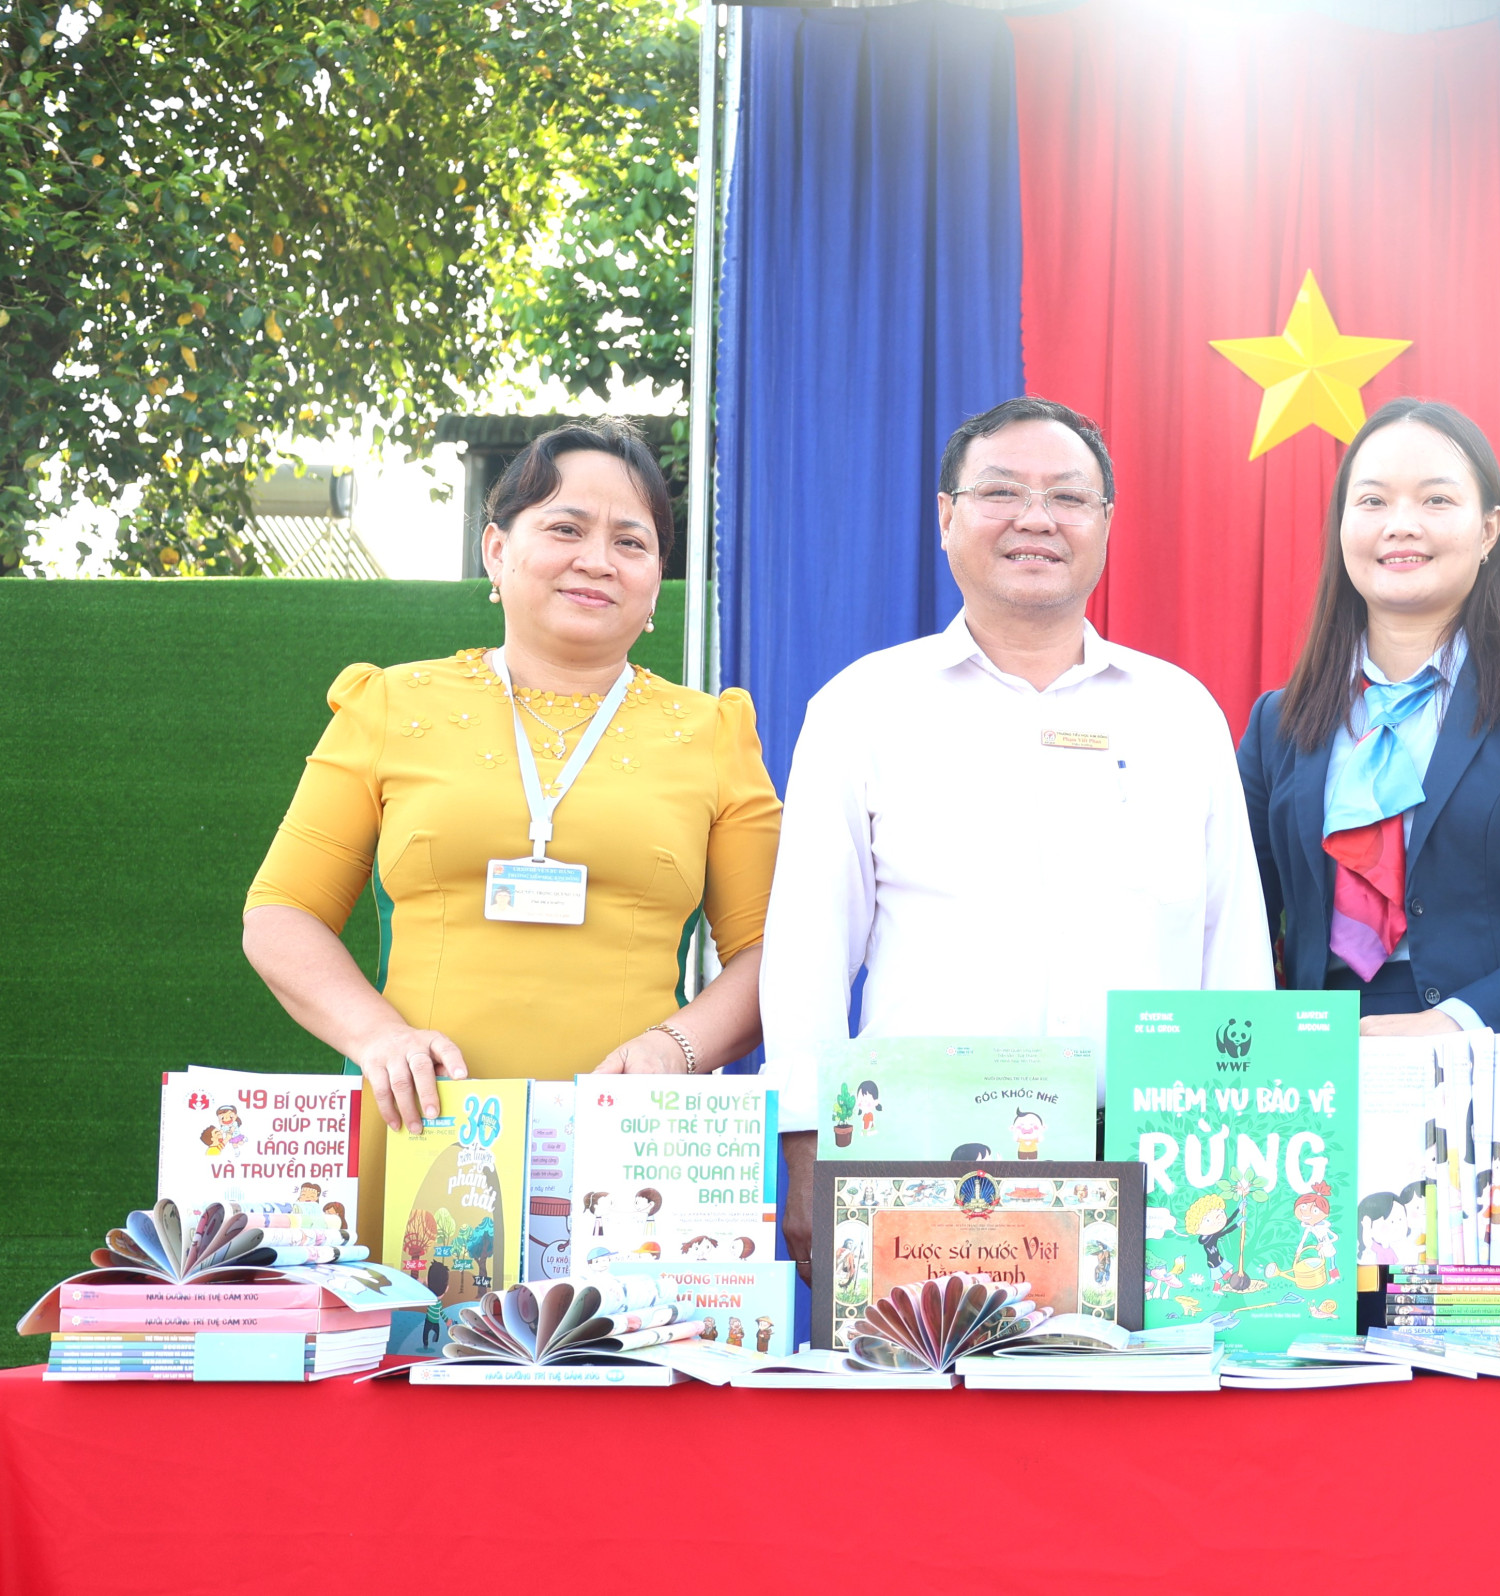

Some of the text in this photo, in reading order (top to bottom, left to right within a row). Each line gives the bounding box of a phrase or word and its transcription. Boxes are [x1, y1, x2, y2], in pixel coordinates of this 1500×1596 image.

[1296, 1011, 1329, 1020] LAURENT
[1134, 1025, 1144, 1033] DE
[1146, 1025, 1155, 1033] LA
[1216, 1061, 1251, 1073] WWF
[238, 1089, 347, 1113] 49 BÍ QUYẾT
[650, 1090, 761, 1113] 42 BÍ QUYẾT
[975, 1087, 1059, 1105] GÓC KHÓC NHÈ
[1133, 1078, 1336, 1119] NHIỆM VỤ BẢO VỆ
[272, 1113, 346, 1133] GIÚP TRẺ
[459, 1095, 500, 1148] 30
[620, 1113, 761, 1137] GIÚP TRẺ TỰ TIN
[257, 1133, 345, 1155] LẮNG NGHE
[633, 1137, 760, 1157] VÀ DŨNG CẢM
[1139, 1117, 1329, 1196] RỪNG
[211, 1157, 344, 1181] VÀ TRUYỀN ĐẠT
[447, 1166, 488, 1195] phẩm
[622, 1162, 760, 1184] TRONG QUAN HỆ
[461, 1185, 497, 1213] chất
[698, 1184, 760, 1207] BẠN BÈ
[893, 1236, 1060, 1264] Lược sử nước Việt
[696, 1290, 742, 1308] NHÂN
